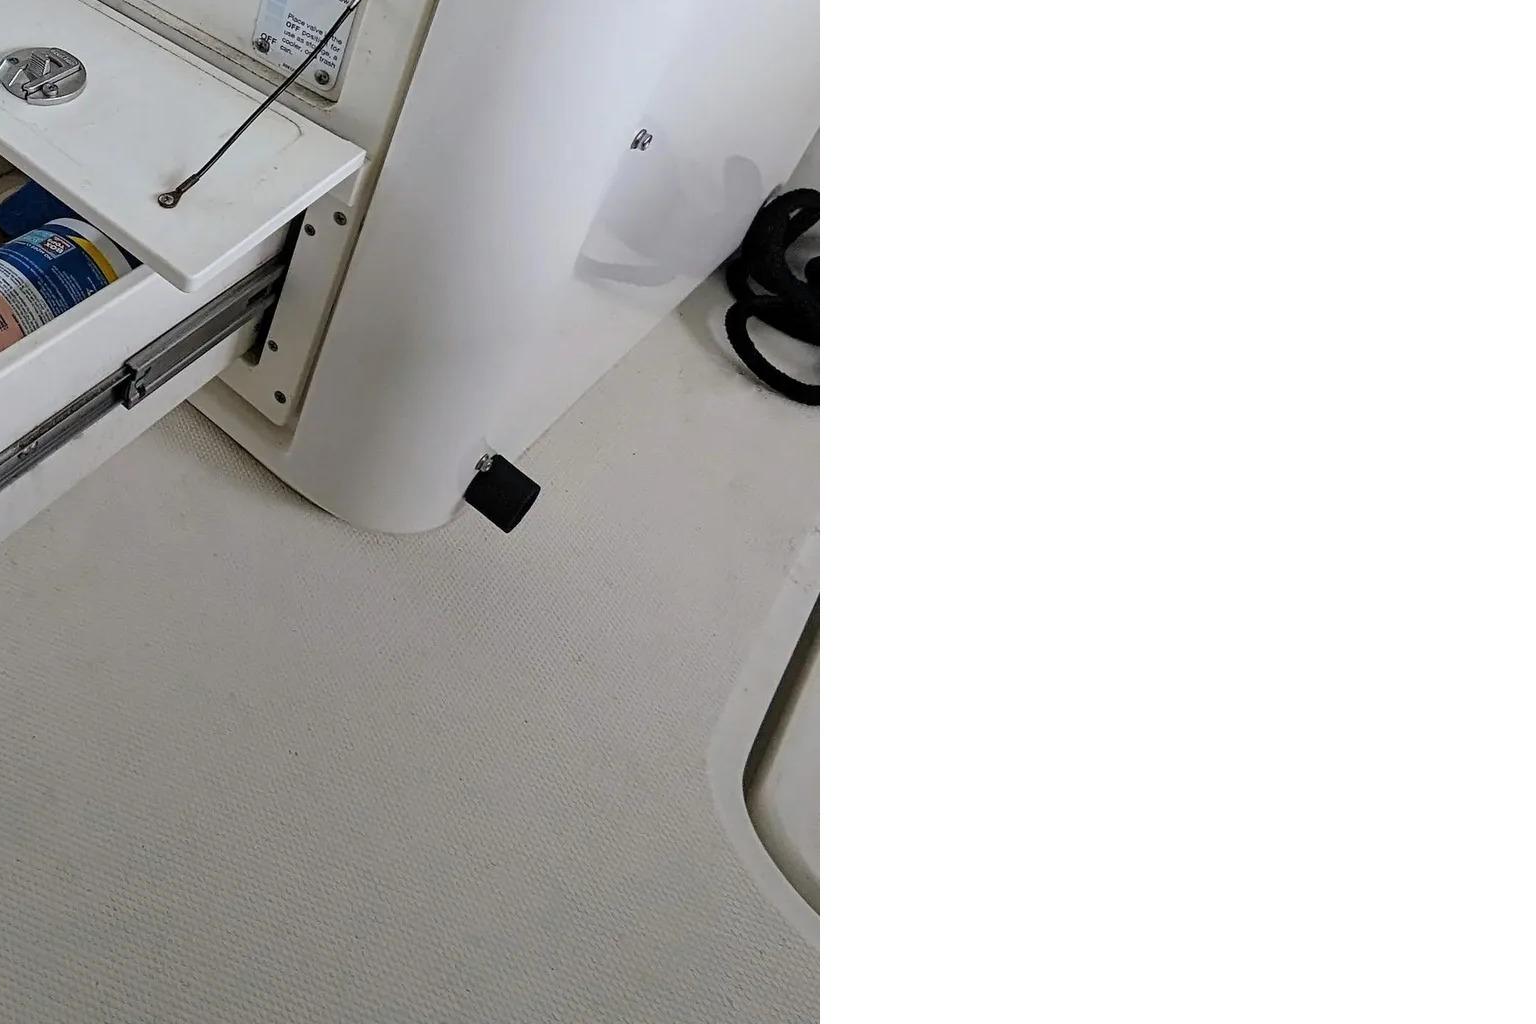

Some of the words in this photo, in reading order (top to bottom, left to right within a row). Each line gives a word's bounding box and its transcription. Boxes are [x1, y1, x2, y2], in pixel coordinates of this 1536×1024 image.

[288, 13, 305, 26] Place
[286, 21, 300, 31] OFF
[261, 33, 277, 45] OFF
